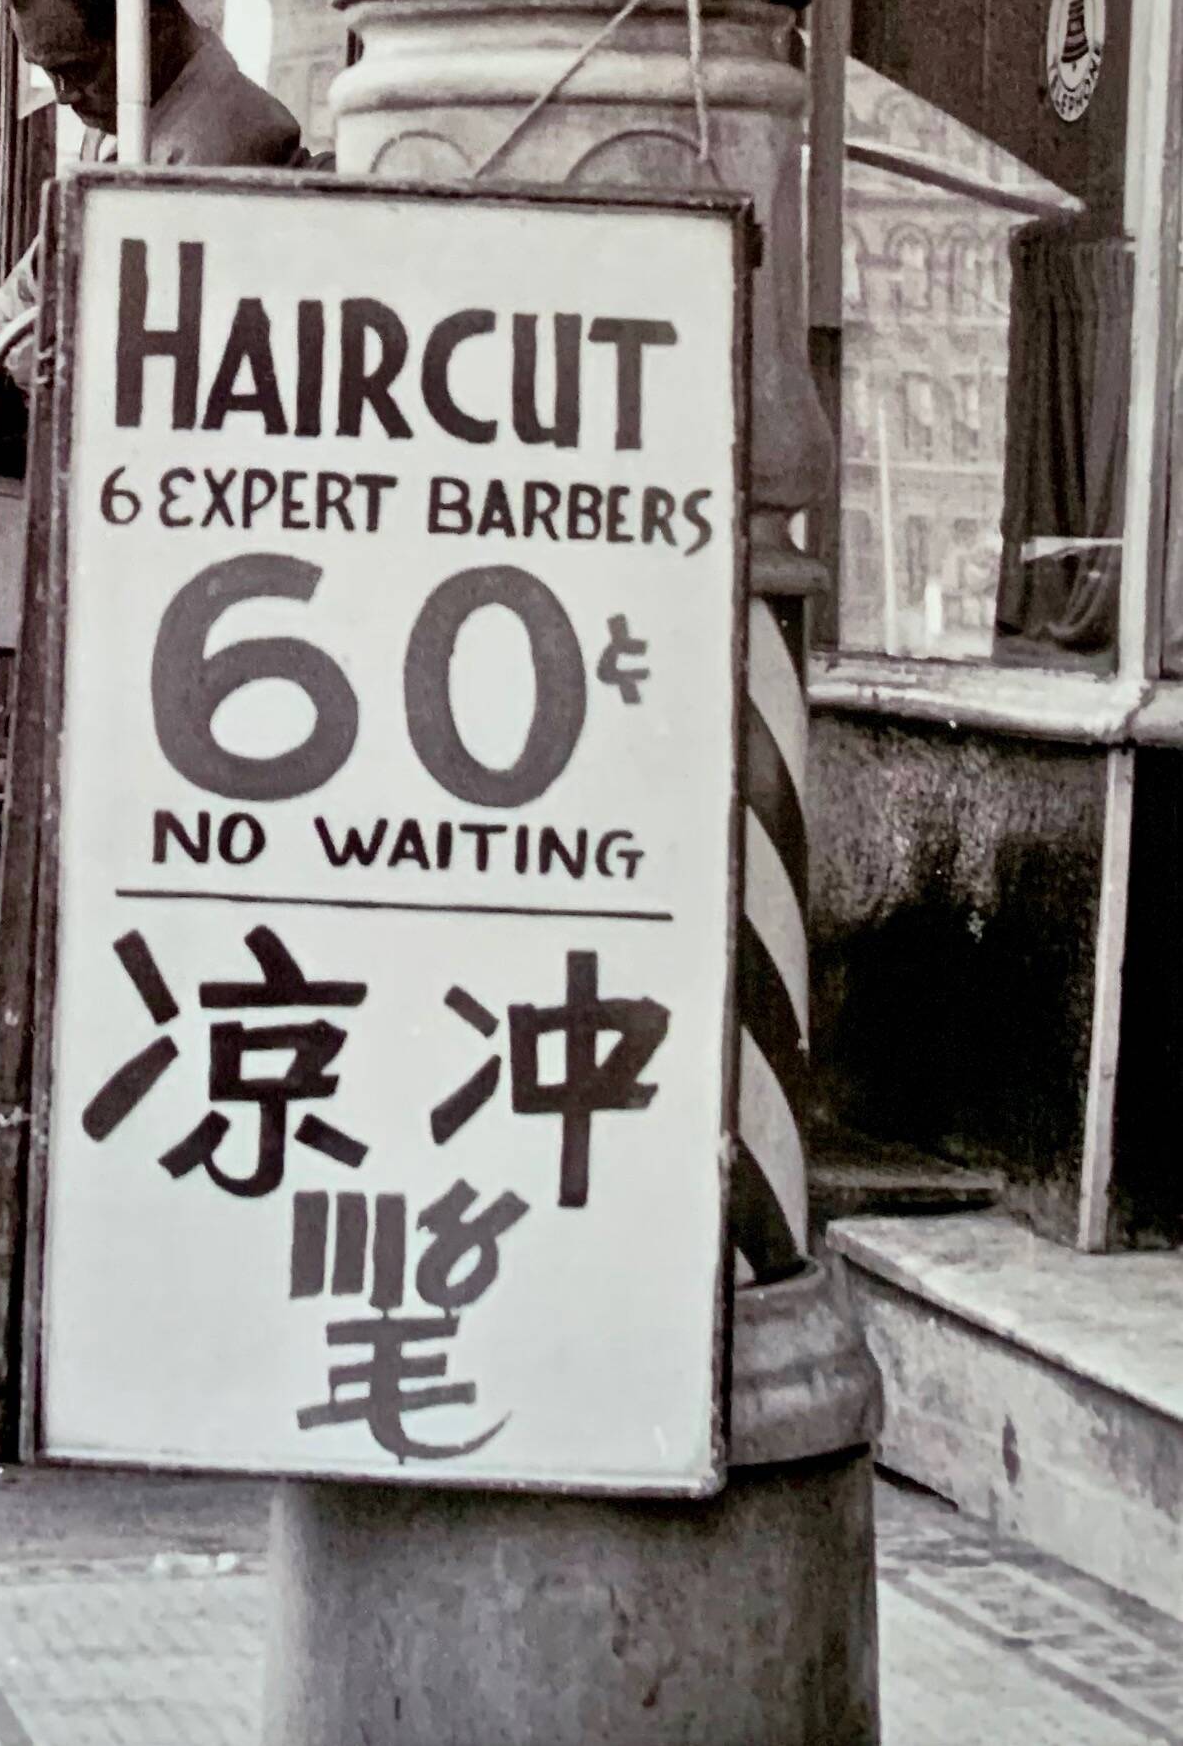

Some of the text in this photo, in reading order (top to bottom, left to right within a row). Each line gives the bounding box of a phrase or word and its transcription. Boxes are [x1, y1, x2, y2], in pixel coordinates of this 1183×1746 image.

[115, 238, 679, 451] HAIRCUT
[99, 466, 714, 556] 6 EXPERT BARBERS
[152, 810, 646, 880] NO WAITING
